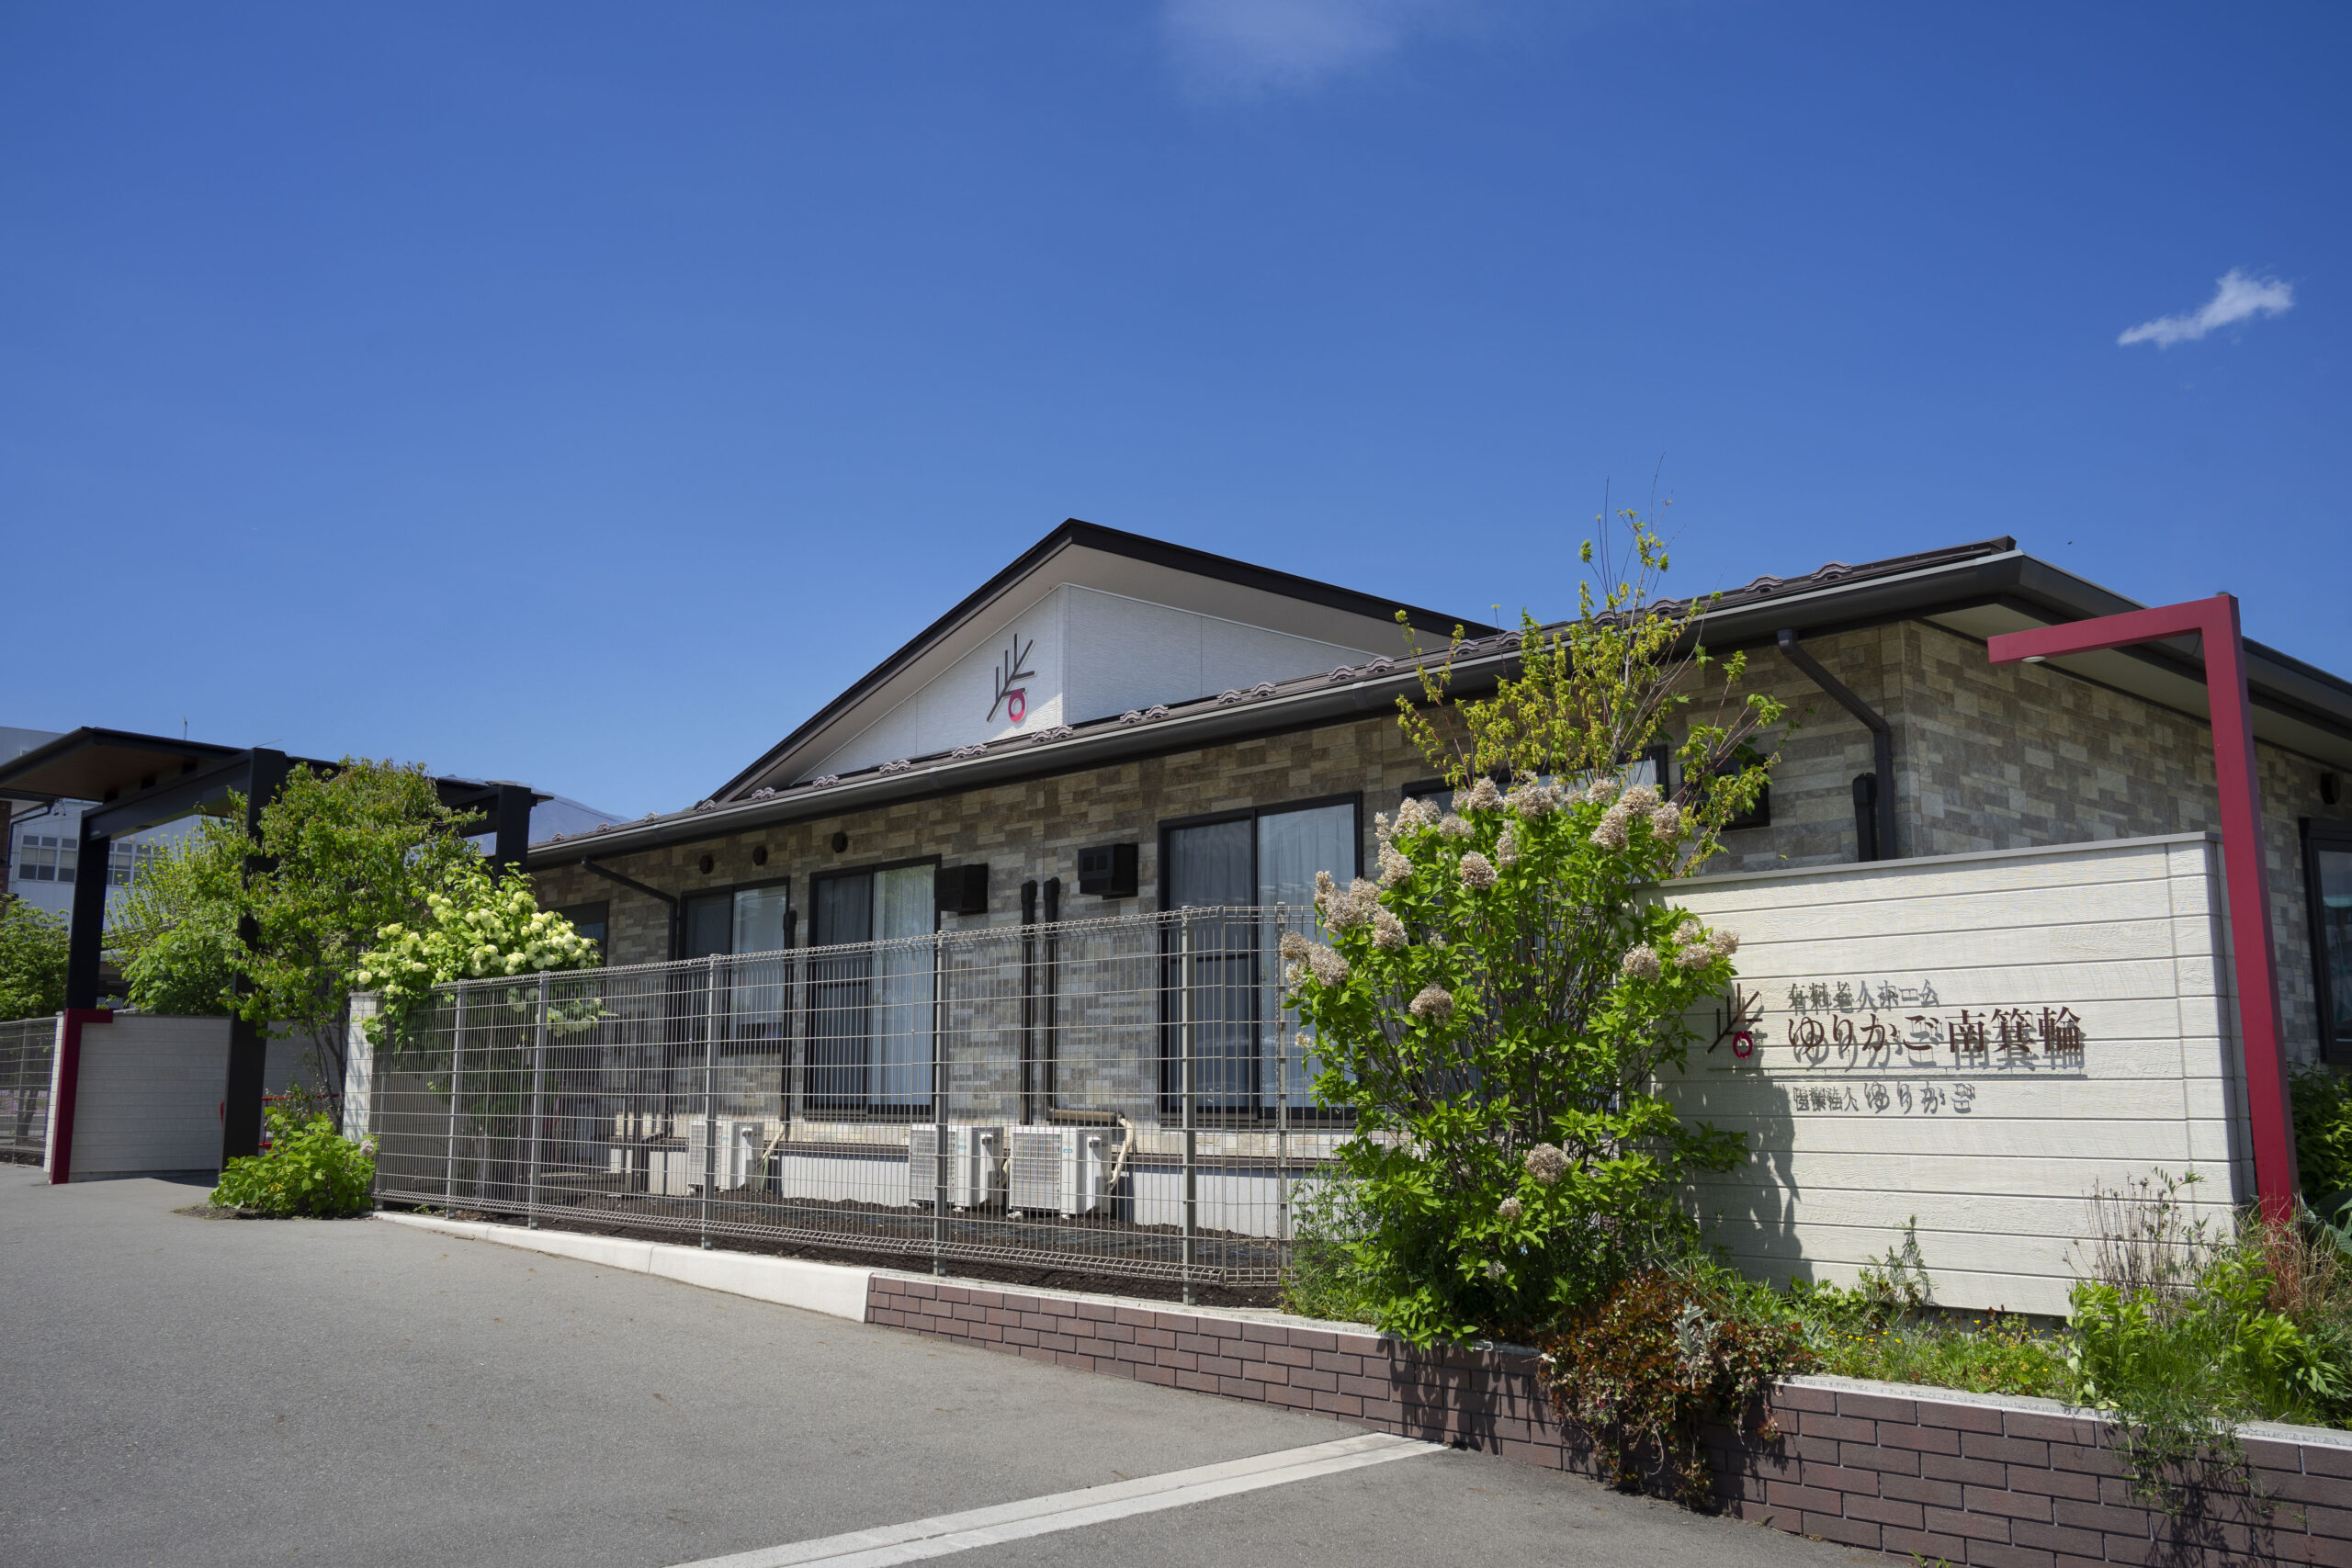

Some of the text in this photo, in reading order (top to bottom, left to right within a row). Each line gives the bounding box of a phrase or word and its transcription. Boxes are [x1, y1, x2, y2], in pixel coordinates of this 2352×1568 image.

[1788, 978, 1938, 1010] 有料老人ホーム
[1788, 1006, 2082, 1055] ゆりかご南箕輪
